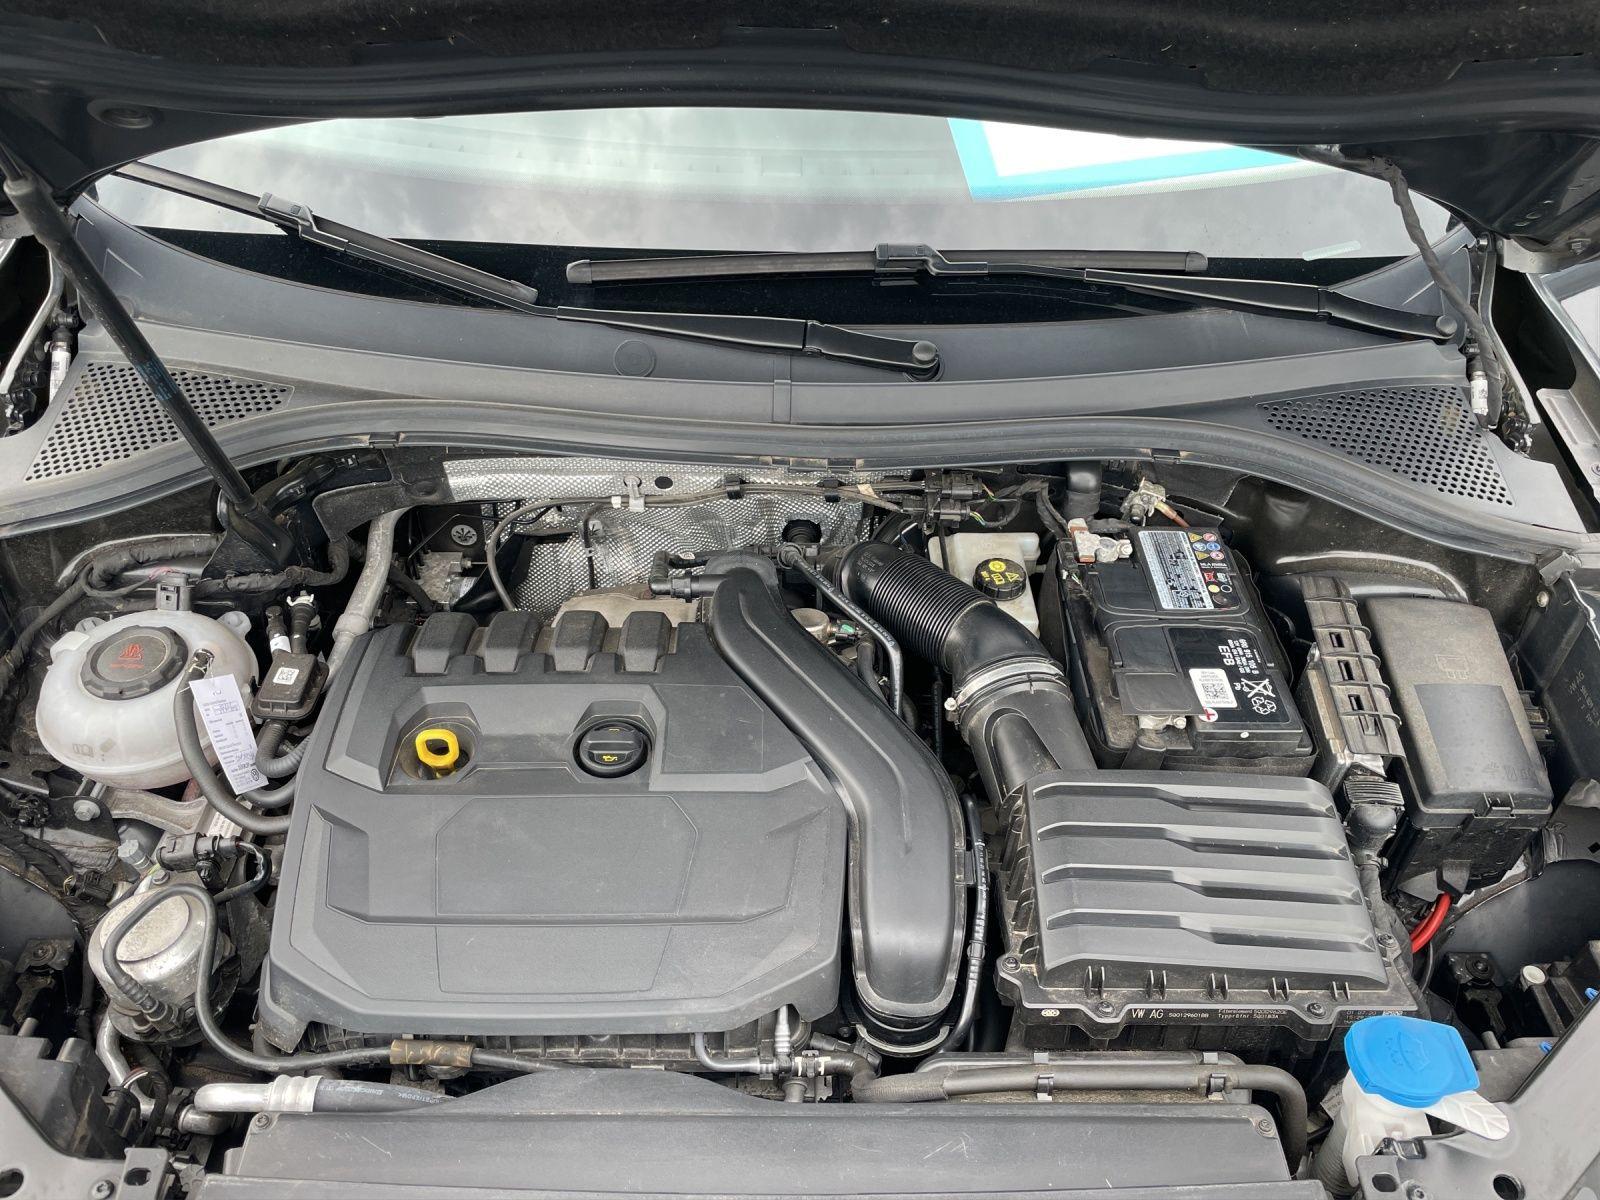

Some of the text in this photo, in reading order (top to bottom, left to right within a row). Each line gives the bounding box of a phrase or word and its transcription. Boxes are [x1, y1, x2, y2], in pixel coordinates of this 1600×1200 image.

[1218, 645, 1236, 666] EFB
[1233, 682, 1241, 691] Pb
[1131, 1009, 1145, 1019] VW
[1150, 1009, 1164, 1019] AG
